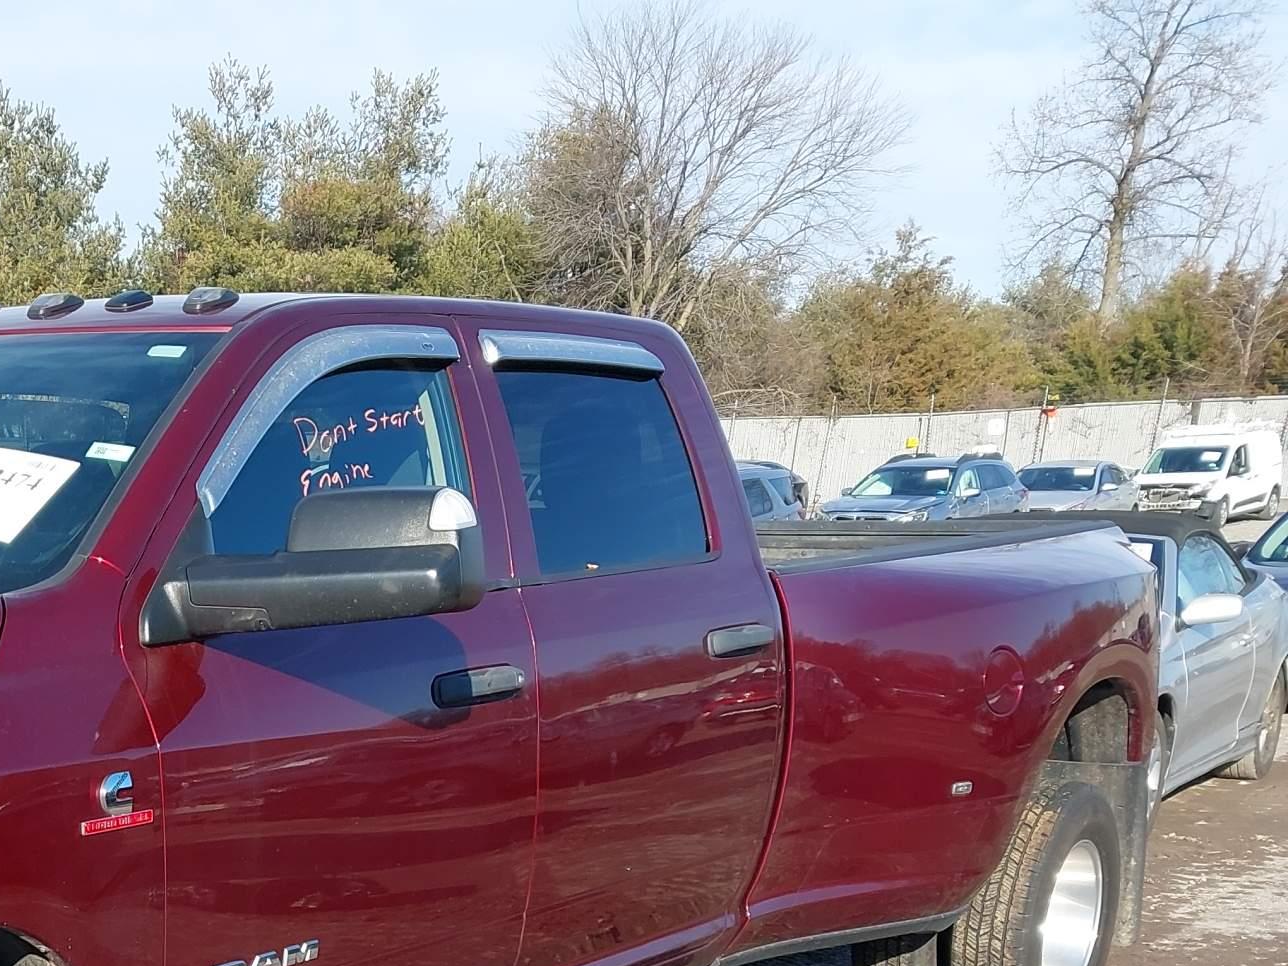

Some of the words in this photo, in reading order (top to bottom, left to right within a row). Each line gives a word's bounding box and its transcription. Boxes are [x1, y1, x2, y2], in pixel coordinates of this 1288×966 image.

[293, 416, 358, 457] Dont
[364, 404, 425, 433] Start
[300, 462, 374, 497] Engine
